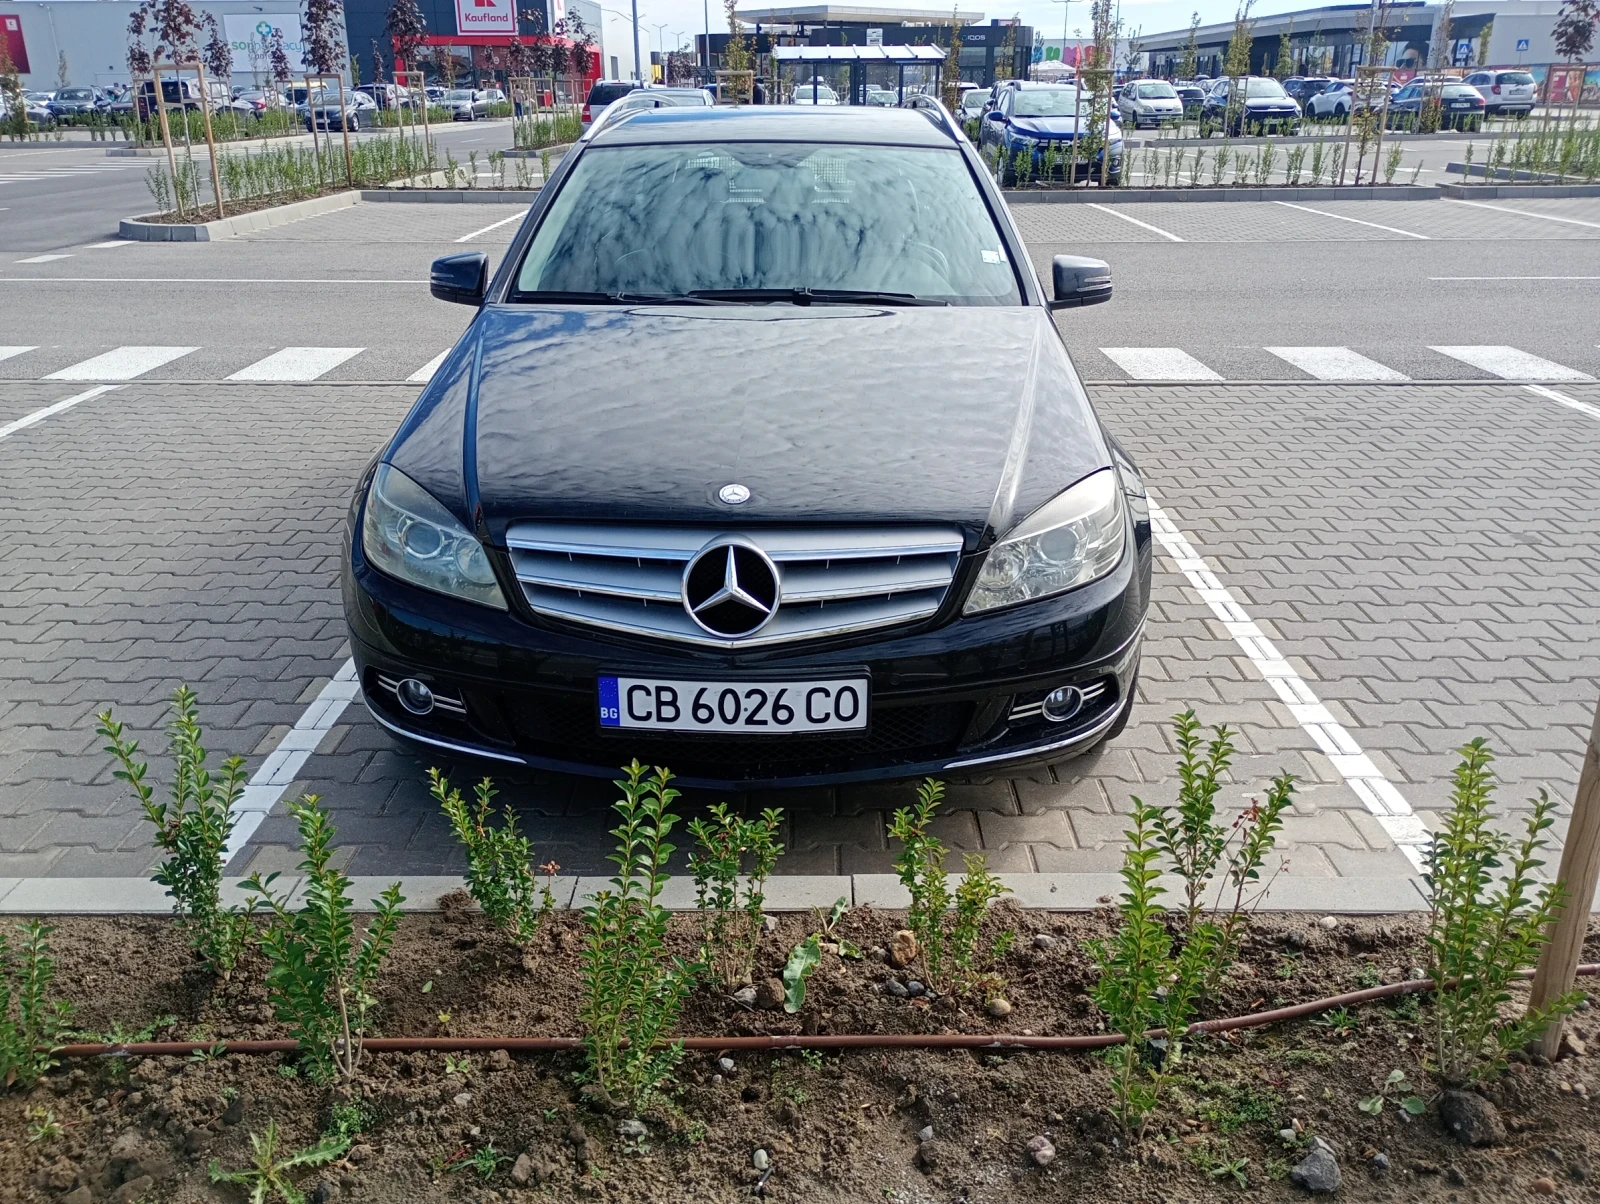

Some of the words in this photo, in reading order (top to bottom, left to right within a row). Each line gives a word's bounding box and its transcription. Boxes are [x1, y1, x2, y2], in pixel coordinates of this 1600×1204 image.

[464, 13, 509, 22] Kaufland
[231, 40, 302, 53] sophacy
[626, 684, 681, 723] CB
[691, 687, 795, 725] 6026
[805, 685, 859, 723] CO
[600, 707, 618, 719] BG
